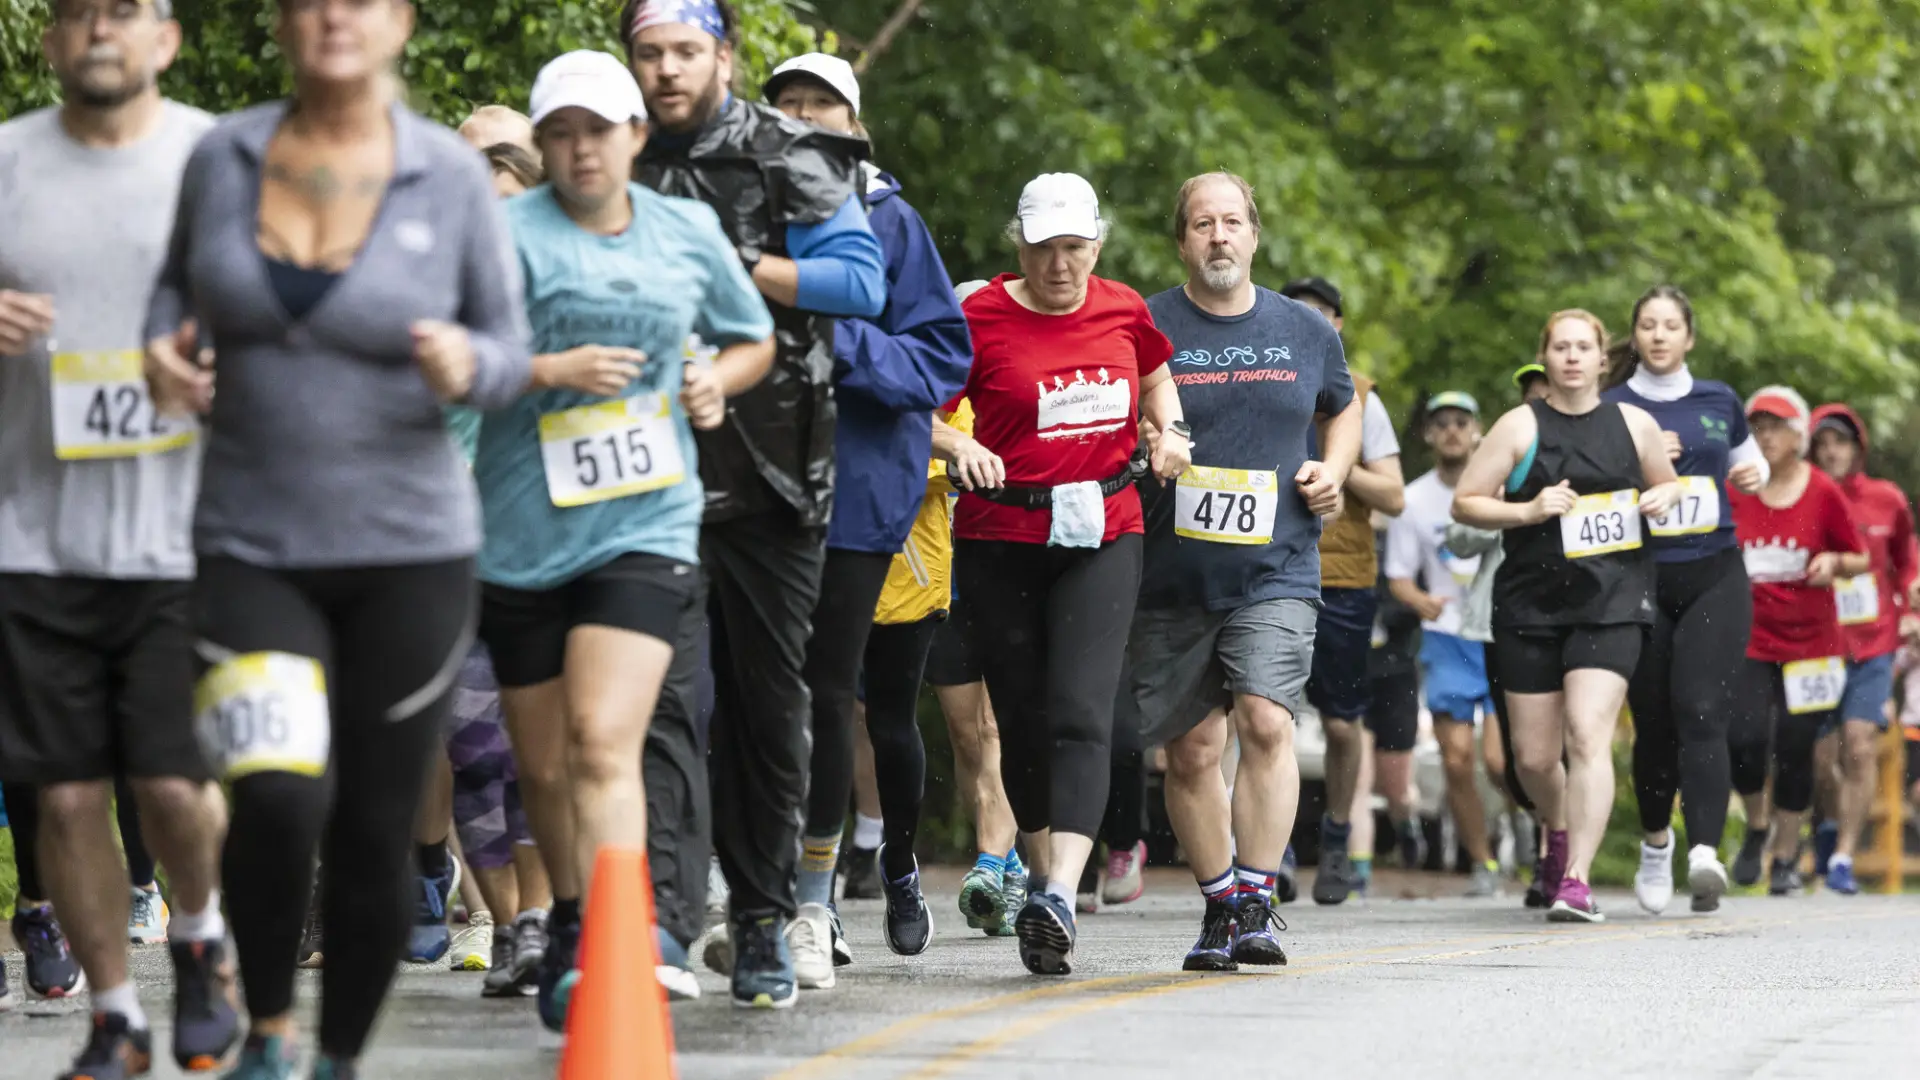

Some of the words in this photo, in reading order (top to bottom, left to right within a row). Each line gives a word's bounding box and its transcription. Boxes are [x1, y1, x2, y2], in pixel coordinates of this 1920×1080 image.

[1172, 371, 1229, 386] TISSING
[1231, 368, 1298, 384] TRIATHLON
[573, 428, 653, 488] 515
[1193, 491, 1257, 534] 478
[1580, 511, 1625, 545] 463
